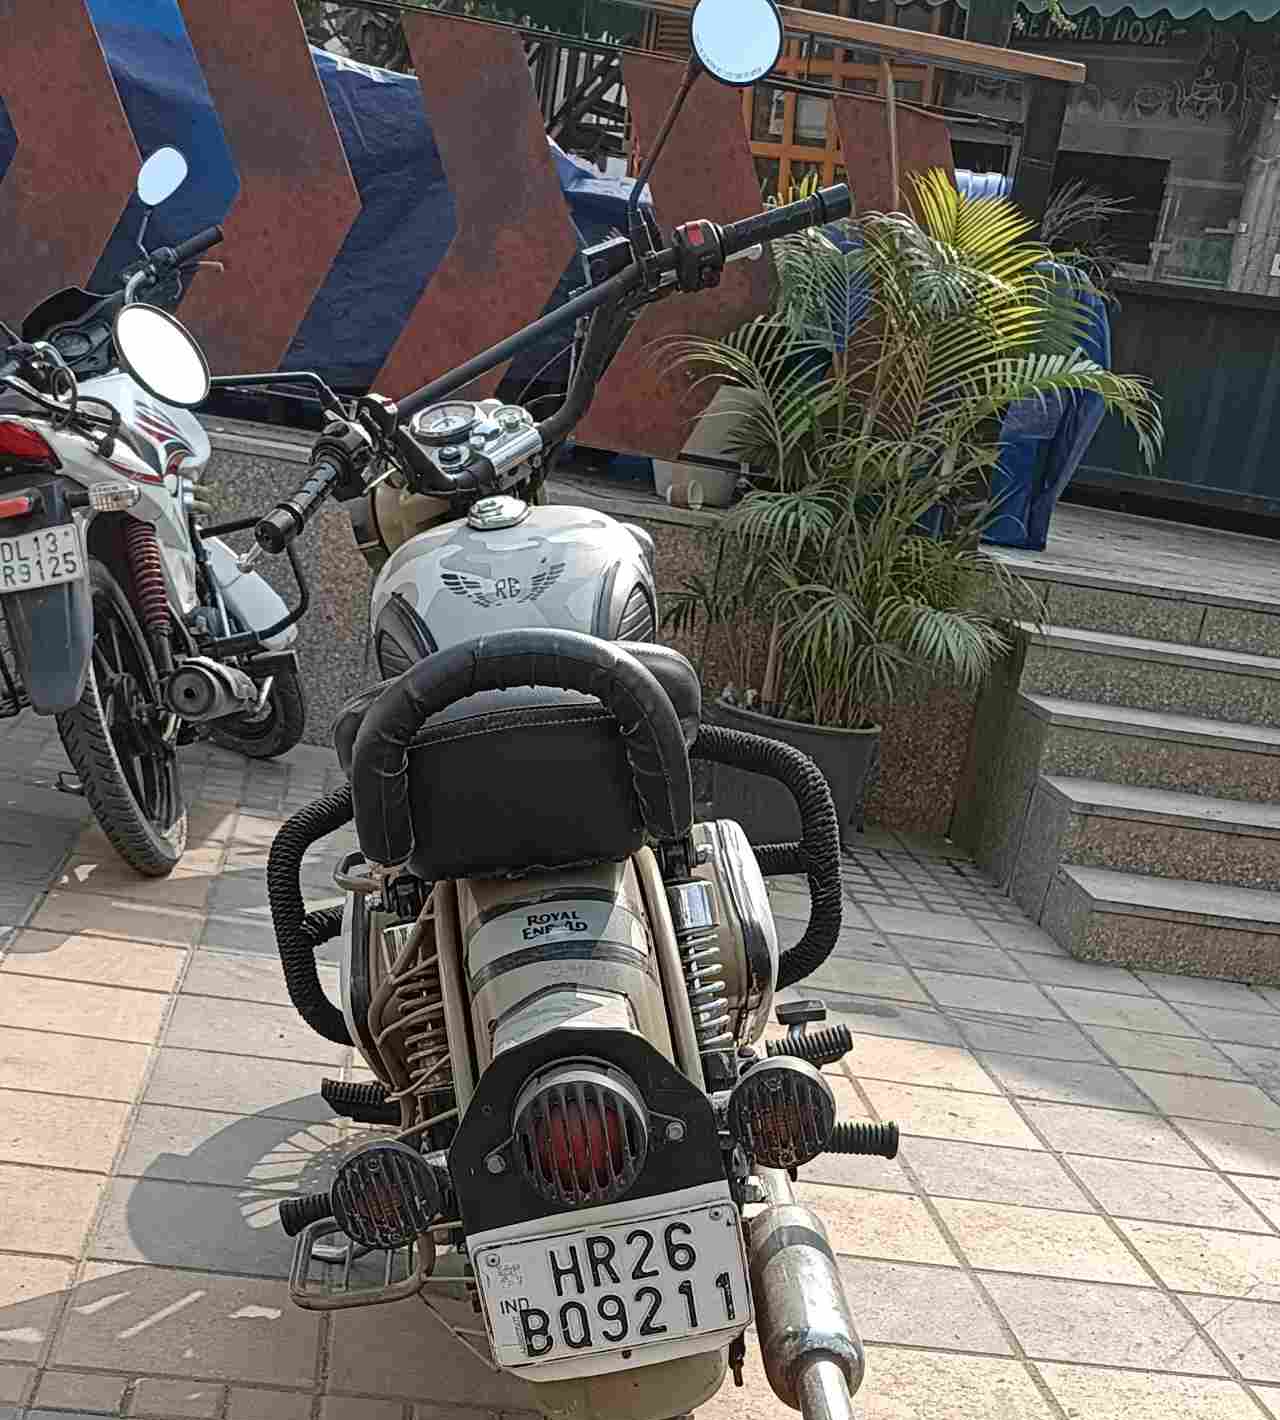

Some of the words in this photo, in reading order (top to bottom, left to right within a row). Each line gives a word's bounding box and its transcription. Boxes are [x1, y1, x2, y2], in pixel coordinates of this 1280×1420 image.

[1112, 20, 1169, 47] DOSE
[0, 532, 58, 563] DL13
[2, 551, 77, 587] R9125
[527, 911, 580, 927] ROYAL
[548, 1221, 697, 1297] HR26
[500, 1297, 530, 1315] IND
[519, 1271, 736, 1358] BQ9211
